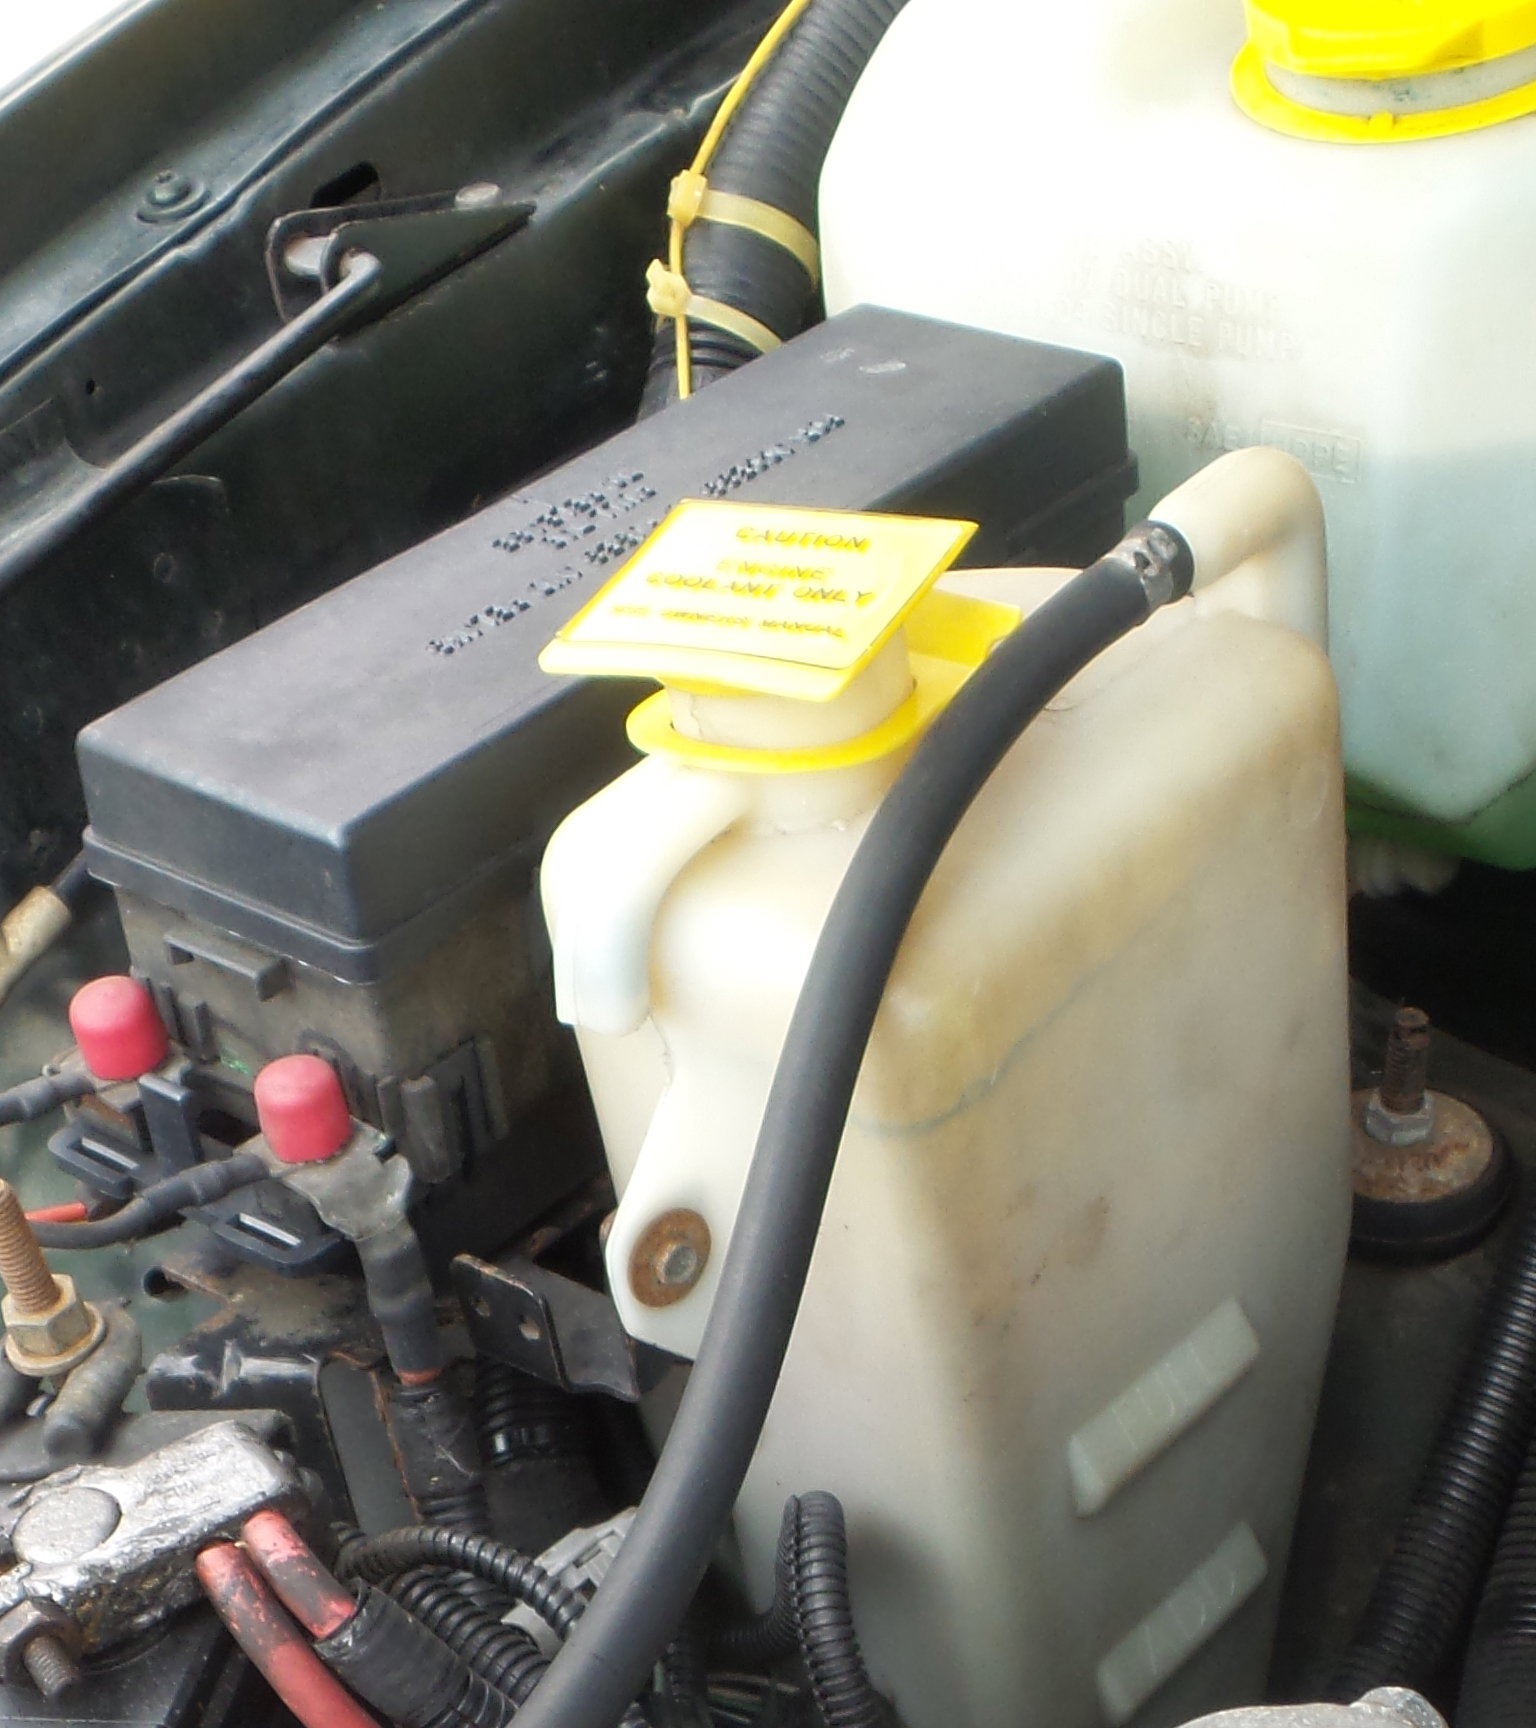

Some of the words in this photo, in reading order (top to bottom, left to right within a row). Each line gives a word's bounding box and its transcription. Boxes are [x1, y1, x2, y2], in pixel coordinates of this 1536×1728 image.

[735, 525, 870, 553] CAUTION
[718, 558, 830, 581] ENGINE
[645, 571, 781, 599] COOLANT
[793, 584, 877, 608] ONLY
